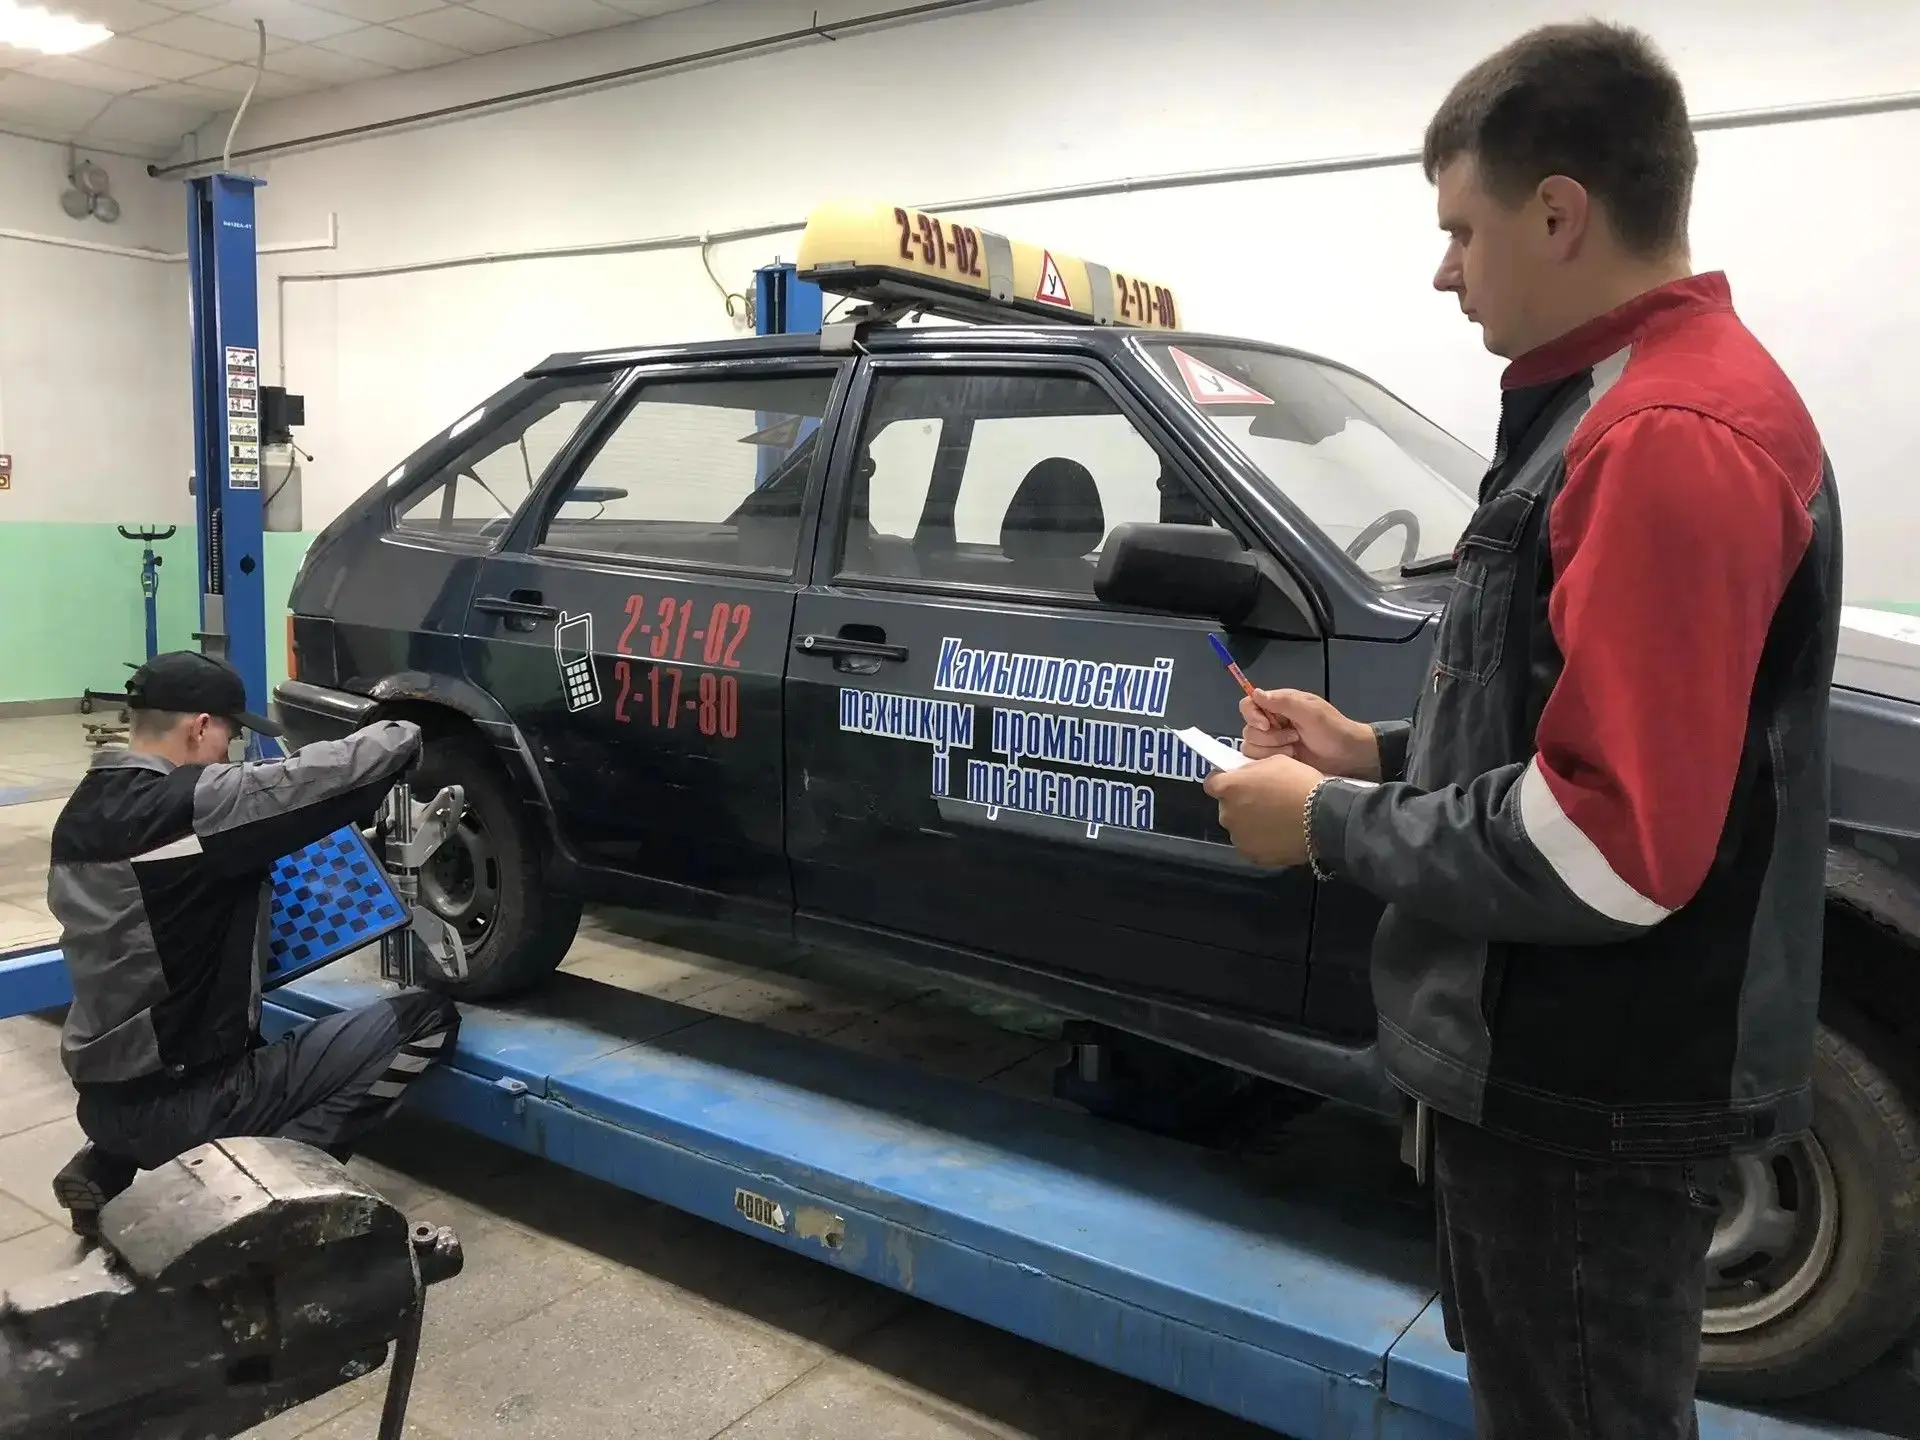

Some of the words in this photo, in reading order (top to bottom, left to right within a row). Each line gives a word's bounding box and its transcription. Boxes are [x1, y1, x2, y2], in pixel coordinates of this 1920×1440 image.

[894, 207, 982, 277] 2-31-02
[1116, 273, 1176, 329] 2-17-80
[616, 594, 751, 668] 2-31-02
[614, 660, 738, 738] 2-17-80
[933, 636, 1175, 718] Камышловский
[839, 687, 975, 754] техникум
[992, 706, 1245, 784] промышленн
[931, 752, 950, 797] и
[967, 759, 1155, 840] транспорта
